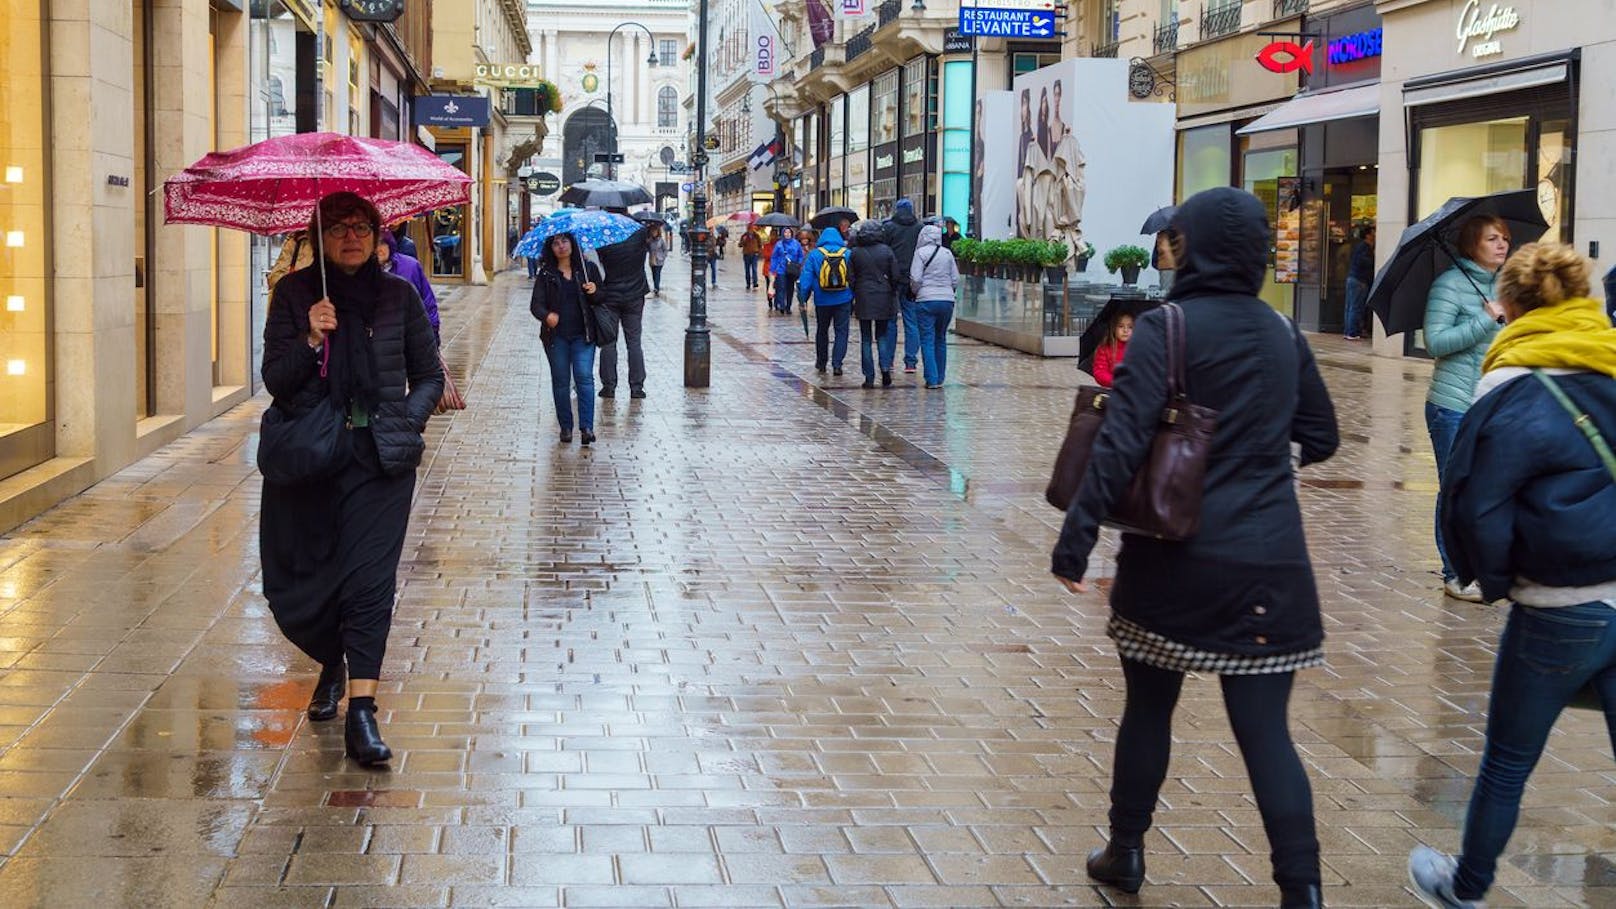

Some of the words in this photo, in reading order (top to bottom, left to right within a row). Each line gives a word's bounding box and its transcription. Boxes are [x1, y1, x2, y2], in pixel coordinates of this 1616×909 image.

[963, 10, 1031, 21] RESTAURANT
[963, 20, 1031, 35] LEVANTE
[758, 35, 770, 70] BDO
[476, 65, 538, 78] GUCCI
